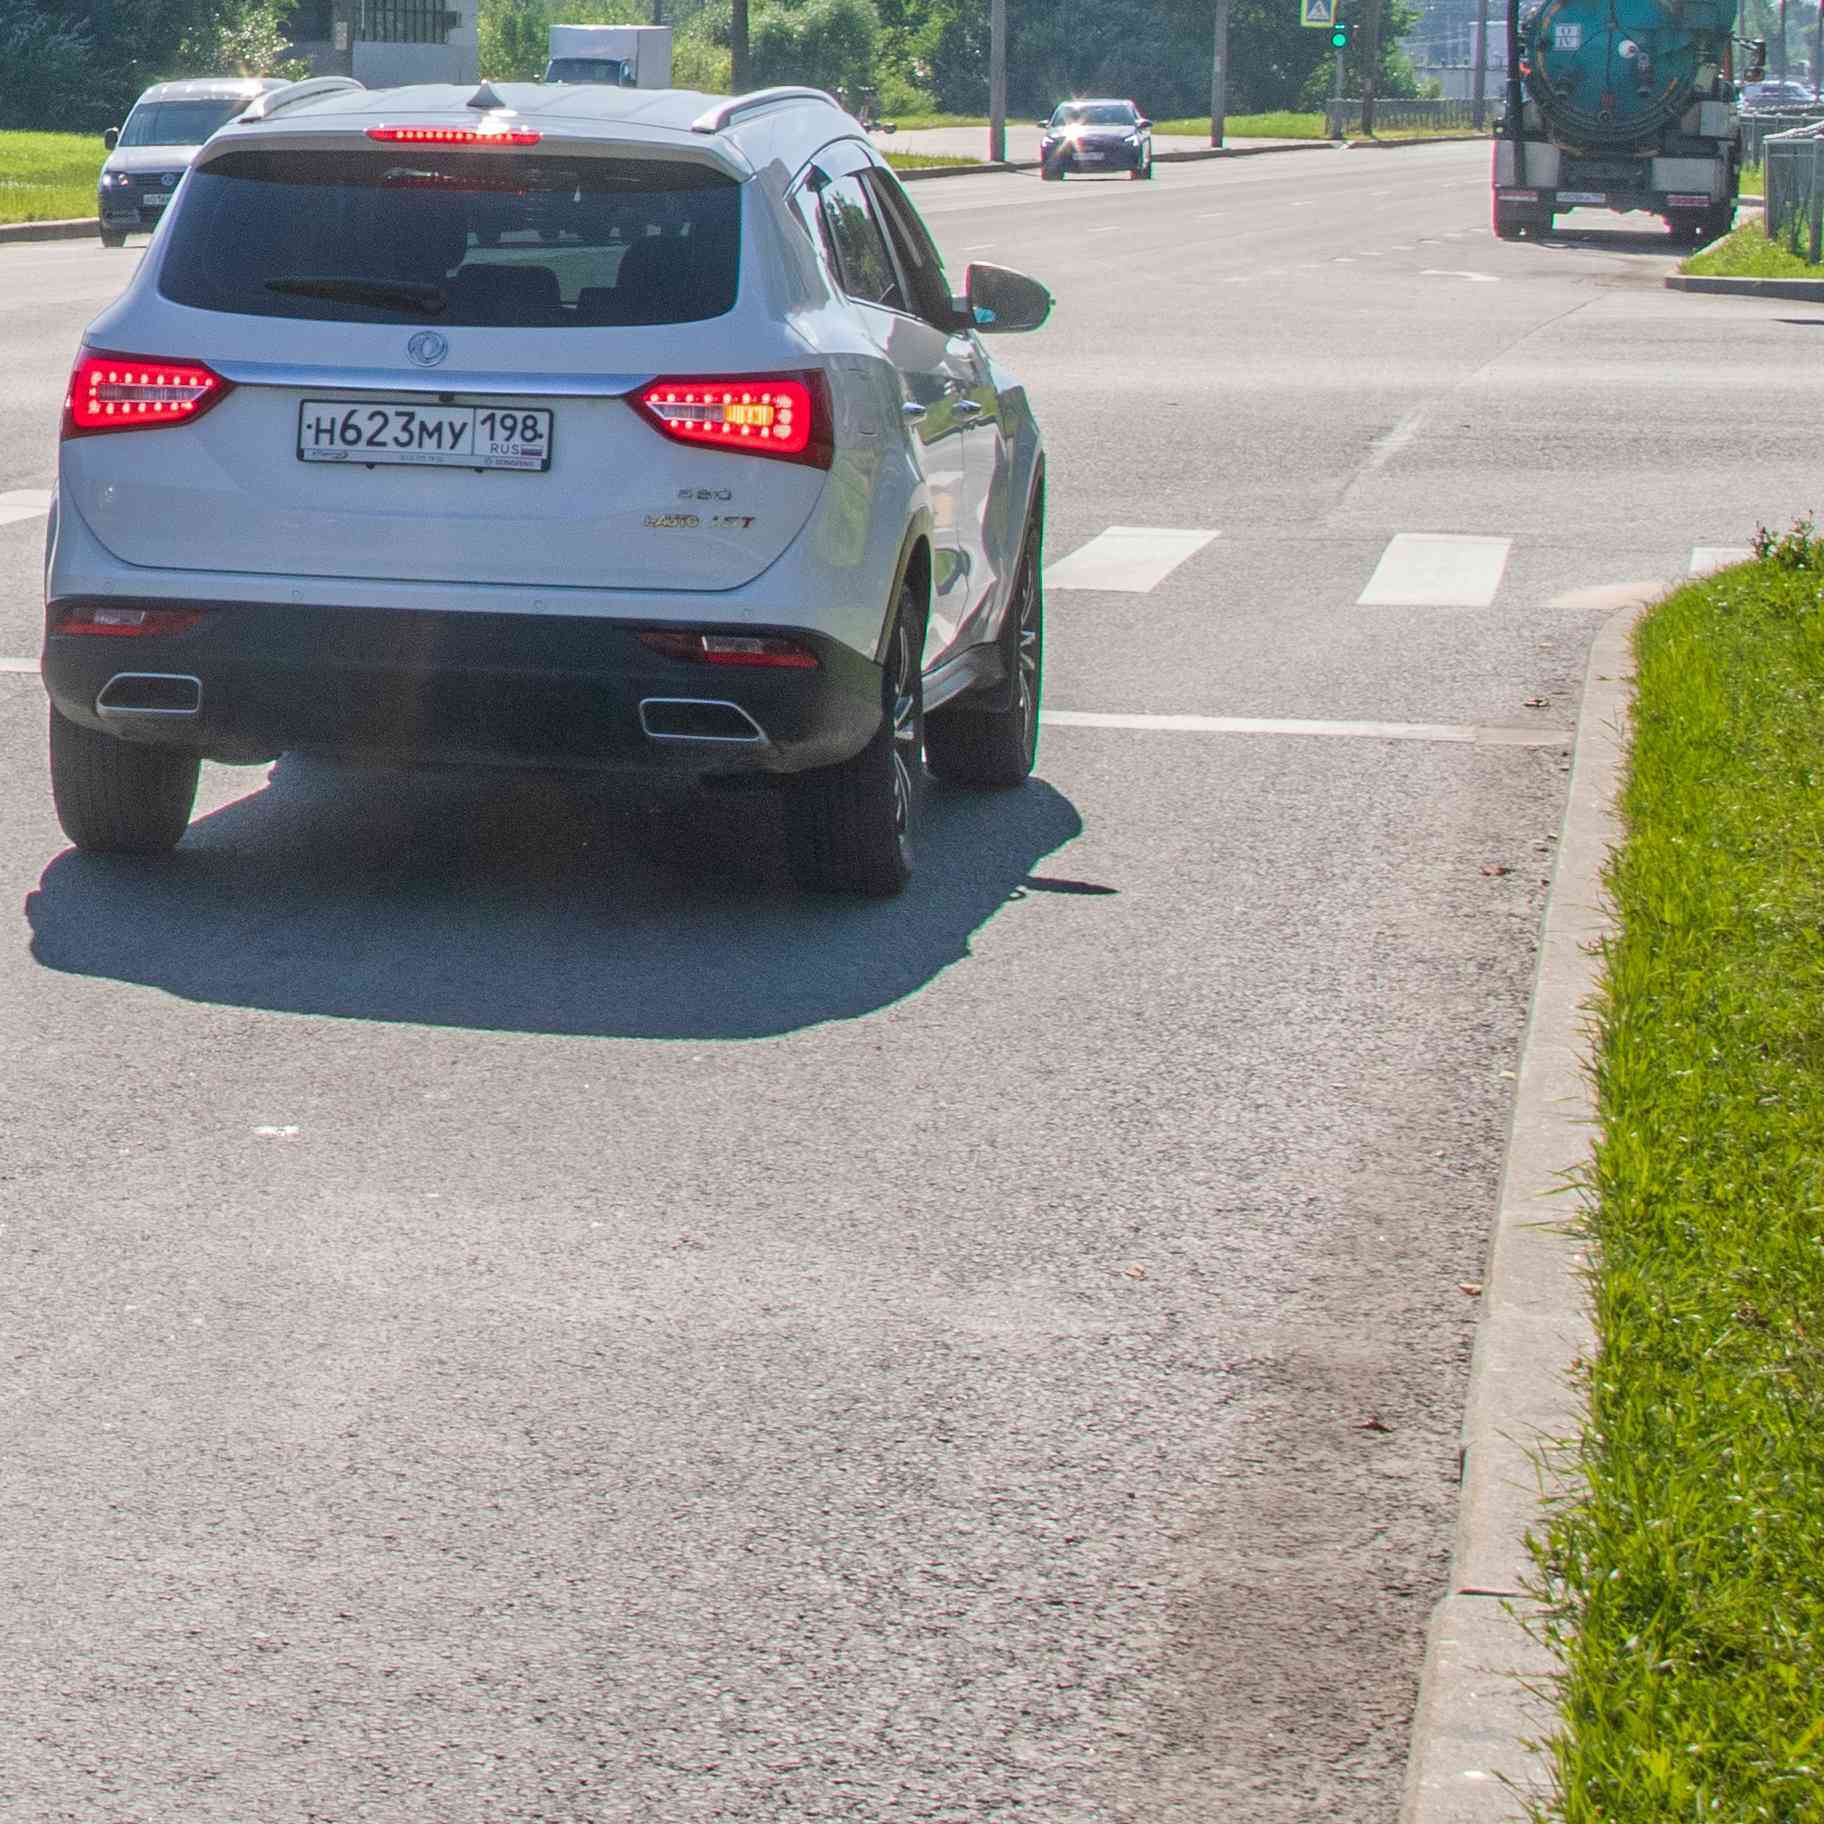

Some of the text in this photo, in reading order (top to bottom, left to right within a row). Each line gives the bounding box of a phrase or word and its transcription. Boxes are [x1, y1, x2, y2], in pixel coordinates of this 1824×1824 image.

[314, 409, 540, 450] Н623МУ 198
[489, 442, 520, 455] RUS
